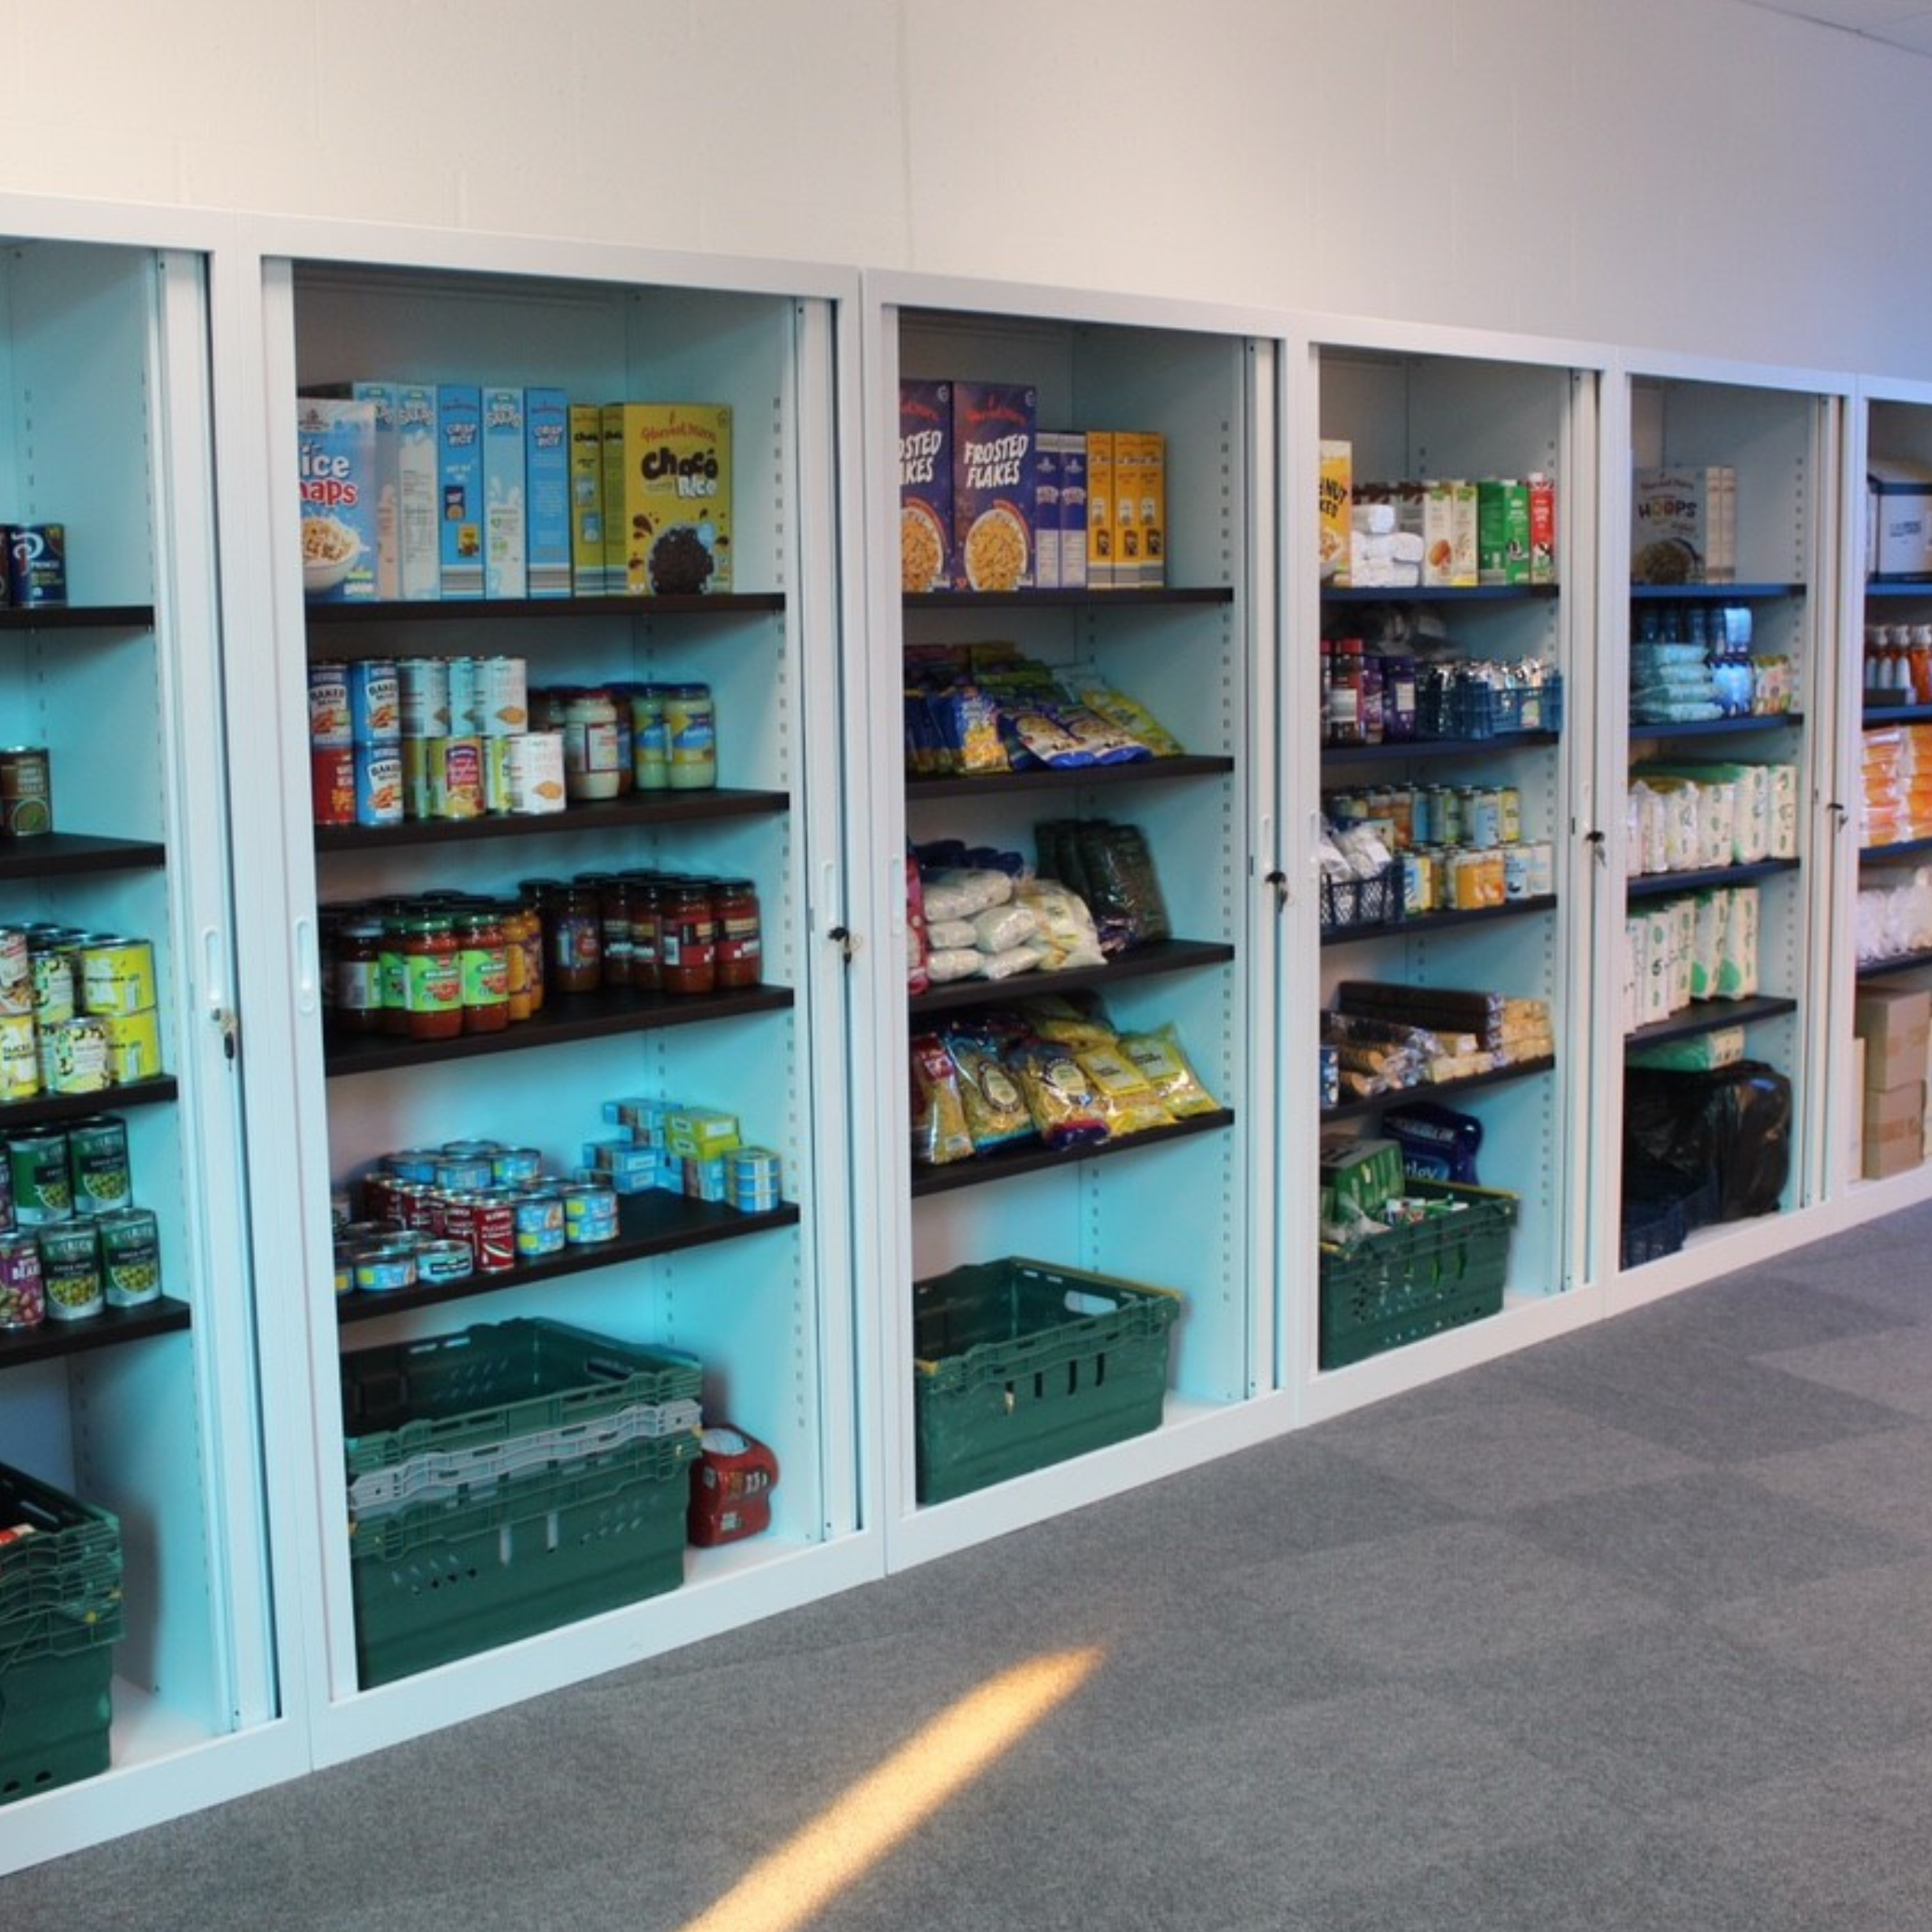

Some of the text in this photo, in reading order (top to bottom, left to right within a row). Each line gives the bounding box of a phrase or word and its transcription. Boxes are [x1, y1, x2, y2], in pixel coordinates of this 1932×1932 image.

[964, 433, 1029, 464] FROSTED
[966, 459, 1020, 489] FLAKES
[1638, 499, 1697, 520] HOOPS
